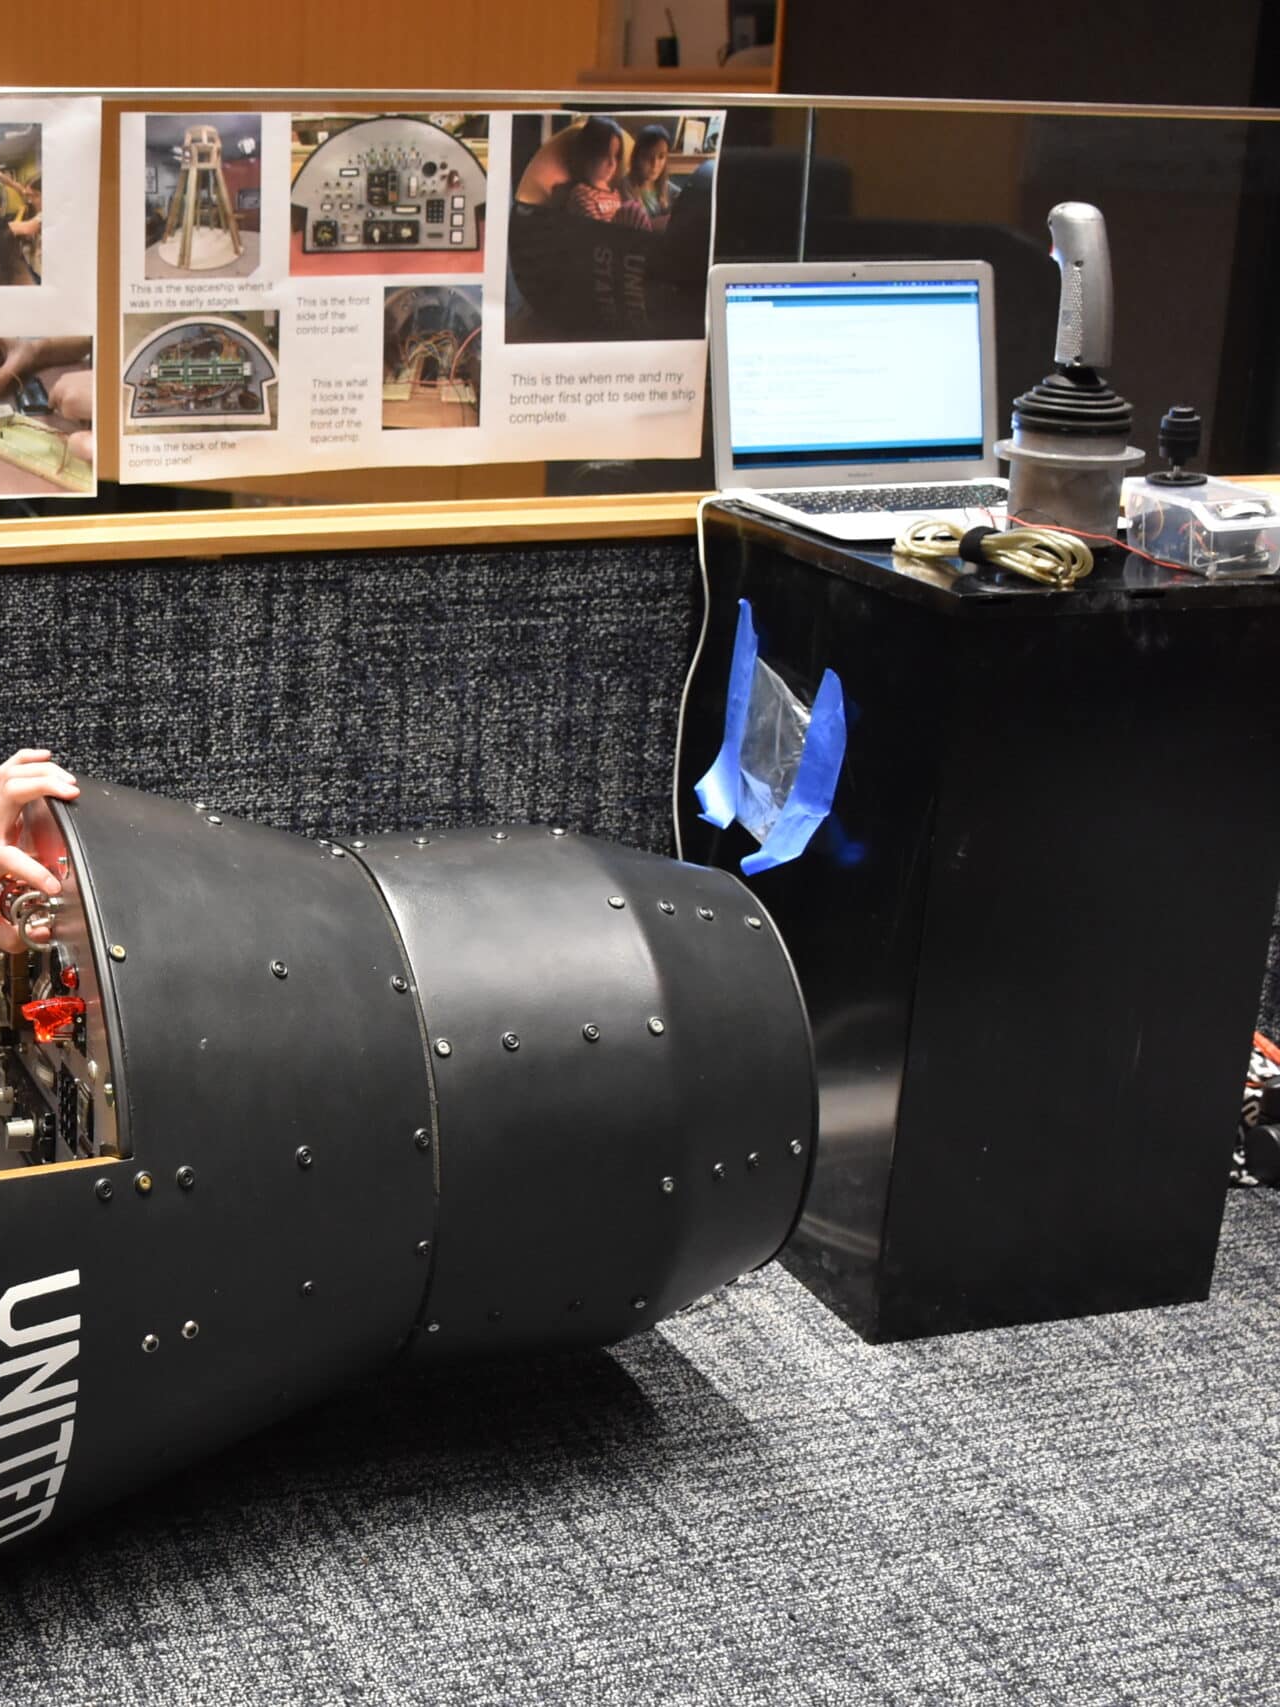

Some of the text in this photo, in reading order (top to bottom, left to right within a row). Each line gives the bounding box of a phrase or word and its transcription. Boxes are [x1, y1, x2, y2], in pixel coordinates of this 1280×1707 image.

[129, 281, 273, 294] This is the spaceship when it
[129, 299, 150, 308] was
[153, 299, 163, 307] in
[165, 298, 177, 307] its
[180, 297, 204, 309] early
[296, 295, 370, 307] This is the front
[296, 310, 346, 321] side of the
[295, 325, 328, 336] control
[312, 378, 368, 389] This is what
[511, 371, 683, 387] This is the when me and my
[311, 391, 364, 402] it looks like
[509, 389, 696, 406] brother first got to see the ship
[310, 406, 357, 416] inside the
[310, 419, 362, 430] front of the
[128, 440, 236, 453] This is the back of the
